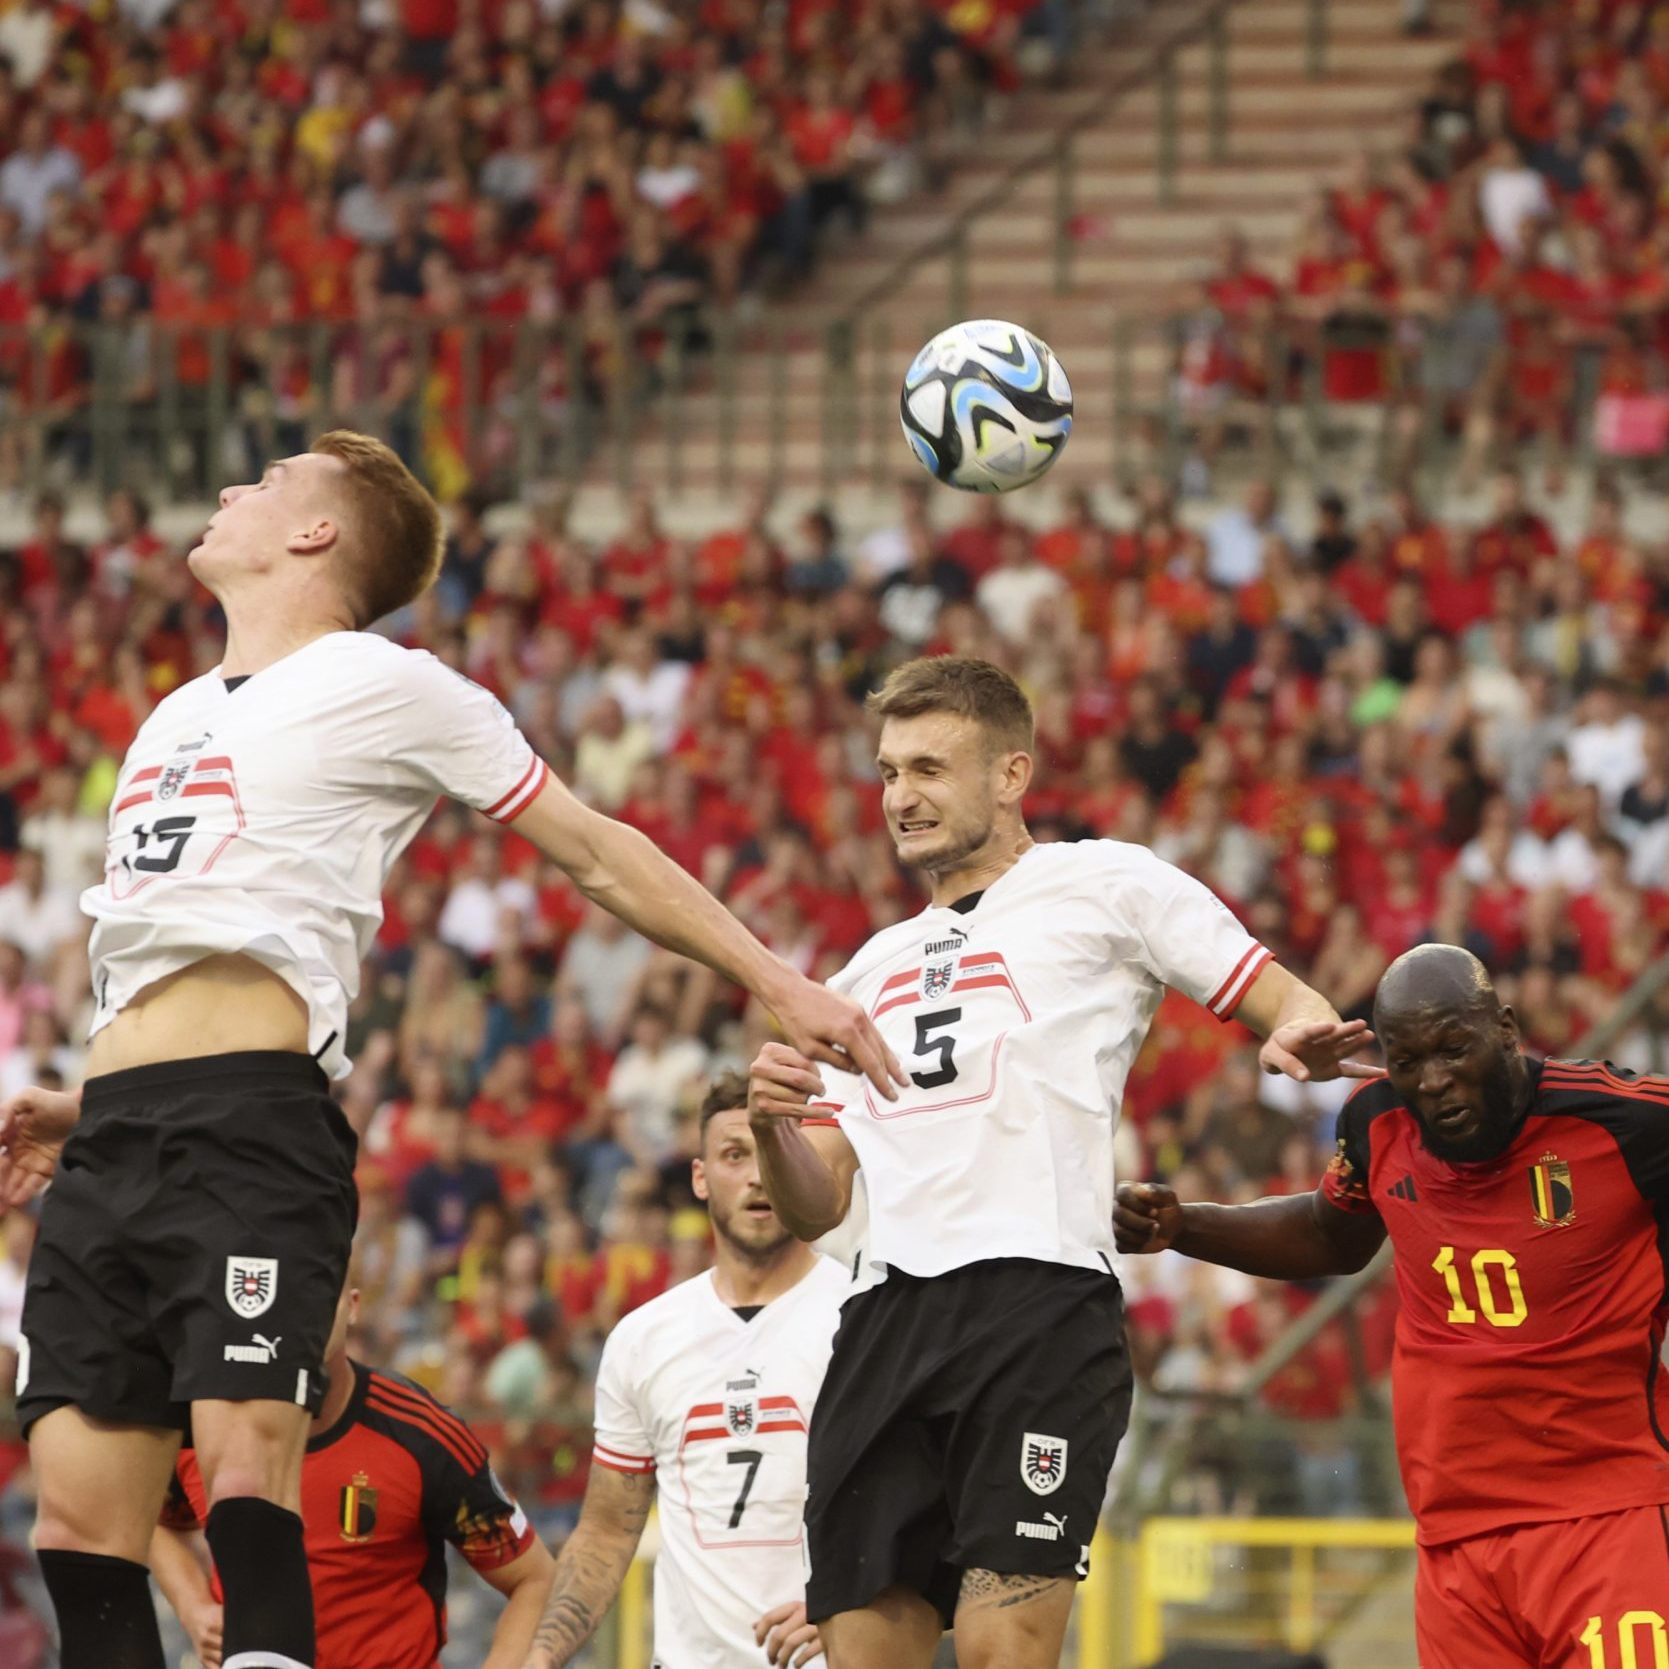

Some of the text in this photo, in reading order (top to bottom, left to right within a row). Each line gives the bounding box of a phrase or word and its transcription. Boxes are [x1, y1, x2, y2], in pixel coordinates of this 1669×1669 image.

[925, 938, 963, 956] PUMA
[910, 1007, 962, 1090] 5
[1432, 1246, 1528, 1327] 10
[224, 1345, 270, 1364] PUMA
[727, 1450, 763, 1529] 7
[1015, 1521, 1058, 1541] PUMA
[1579, 1610, 1669, 1669] 10
